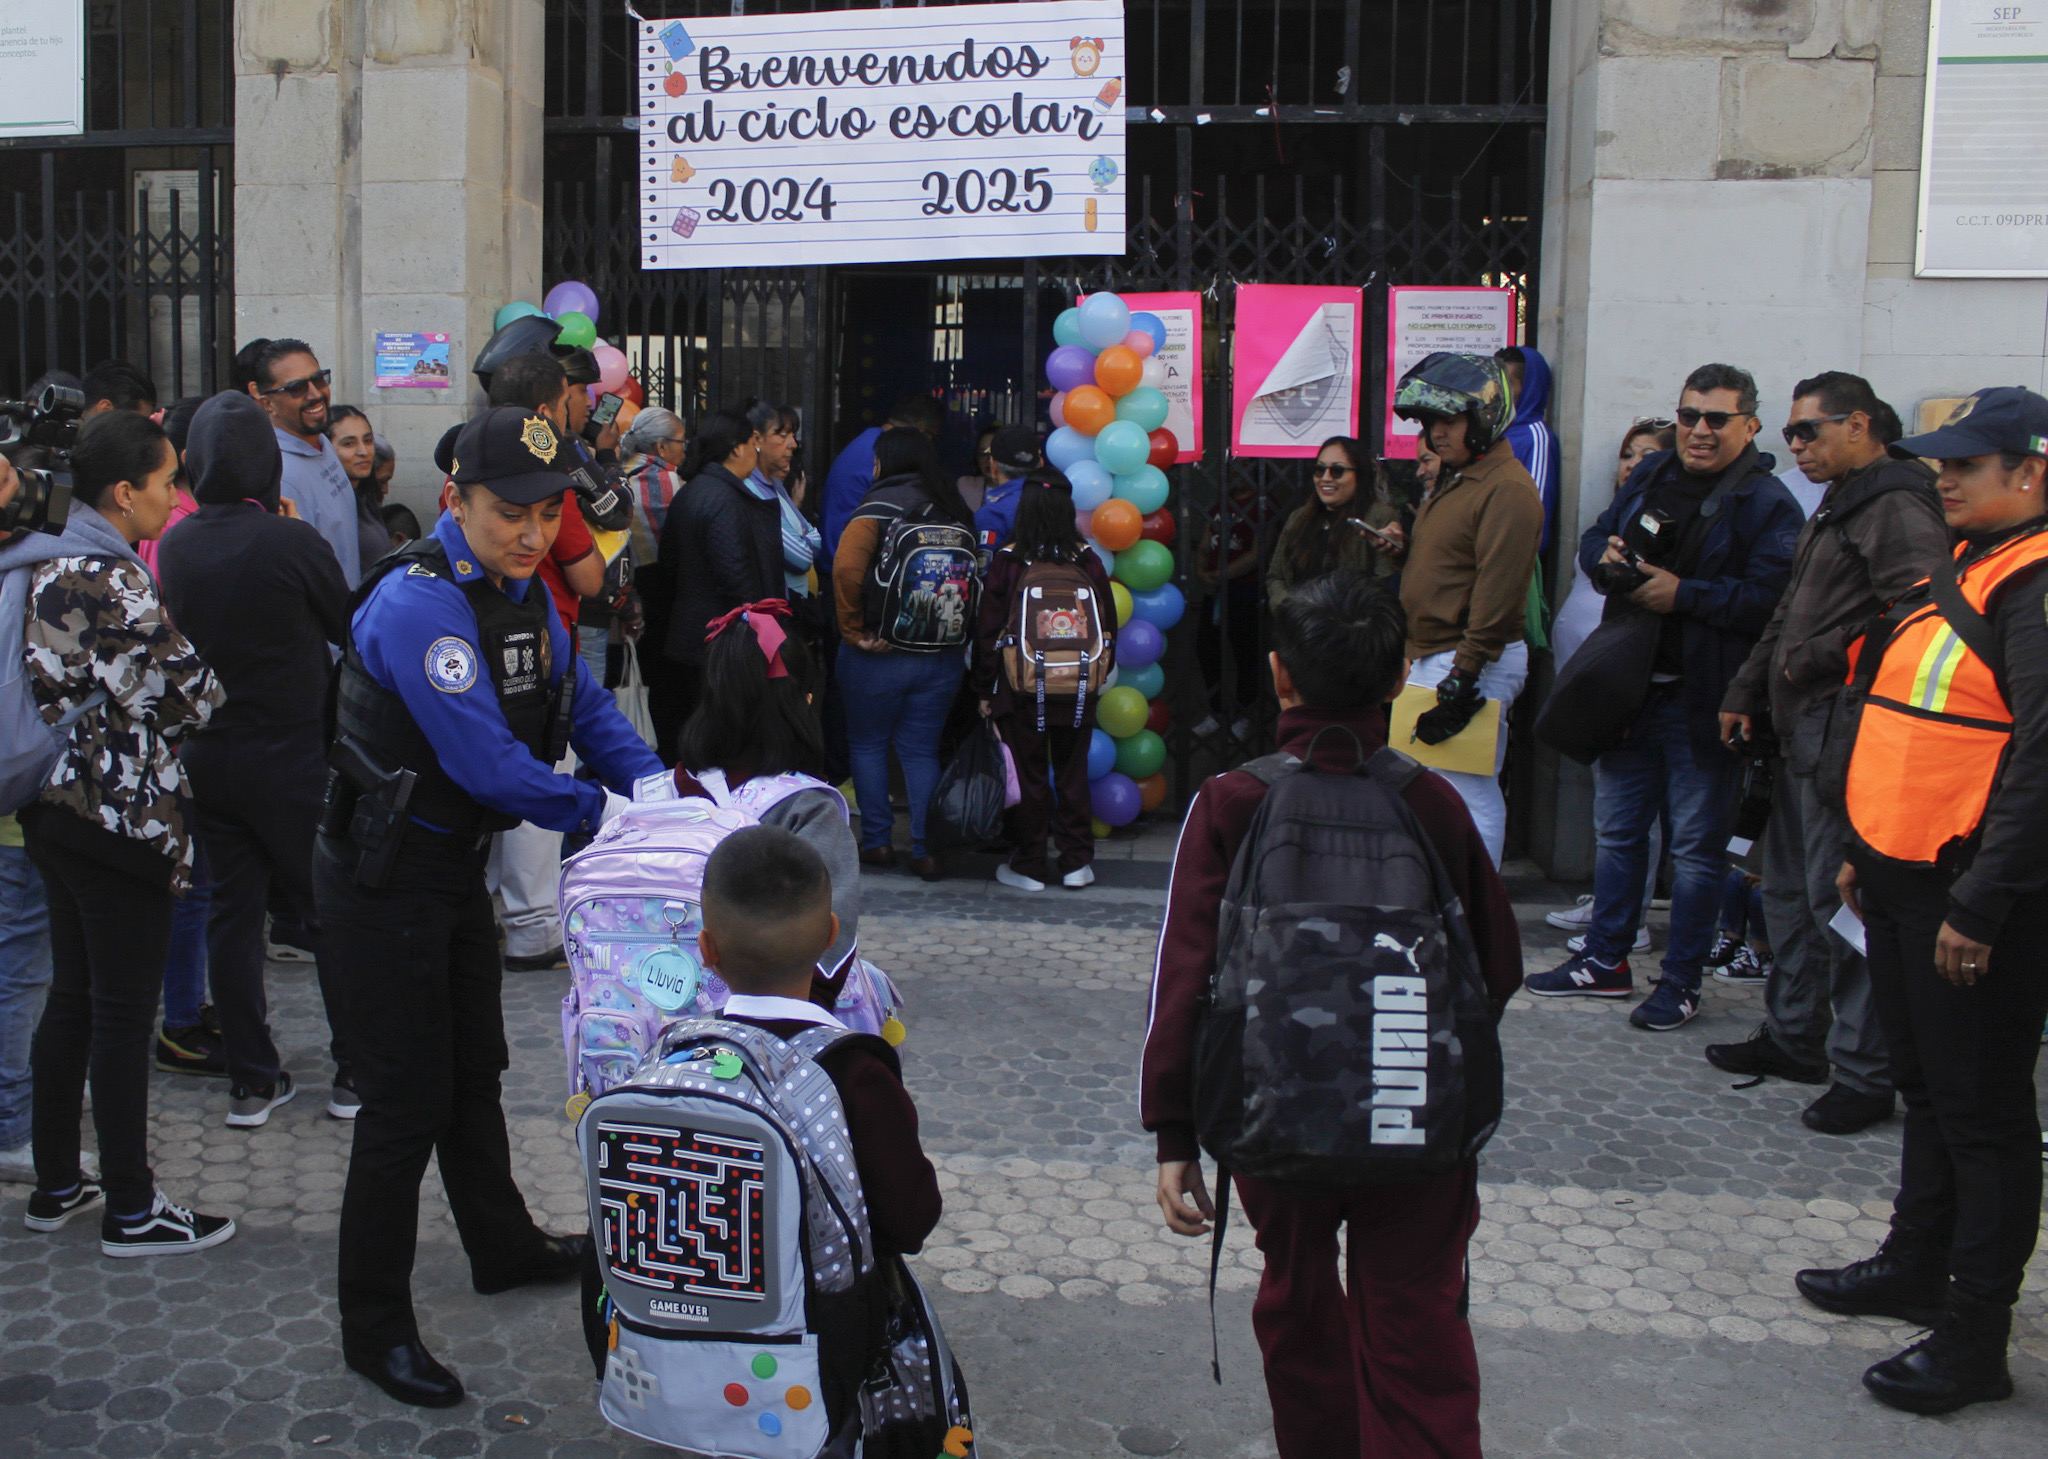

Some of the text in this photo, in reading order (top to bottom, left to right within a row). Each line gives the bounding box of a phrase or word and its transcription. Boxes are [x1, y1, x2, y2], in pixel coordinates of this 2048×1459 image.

[1993, 7, 2021, 20] SEP
[699, 38, 1049, 93] Bienvenidos
[666, 92, 1103, 143] al ciclo escolar
[706, 167, 1053, 222] 2024 2025
[1956, 215, 1992, 226] C.C.T.
[594, 493, 617, 513] PUMA
[1569, 967, 1596, 987] N
[1370, 975, 1428, 1145] PUMA
[650, 1299, 708, 1316] GAME OVER
